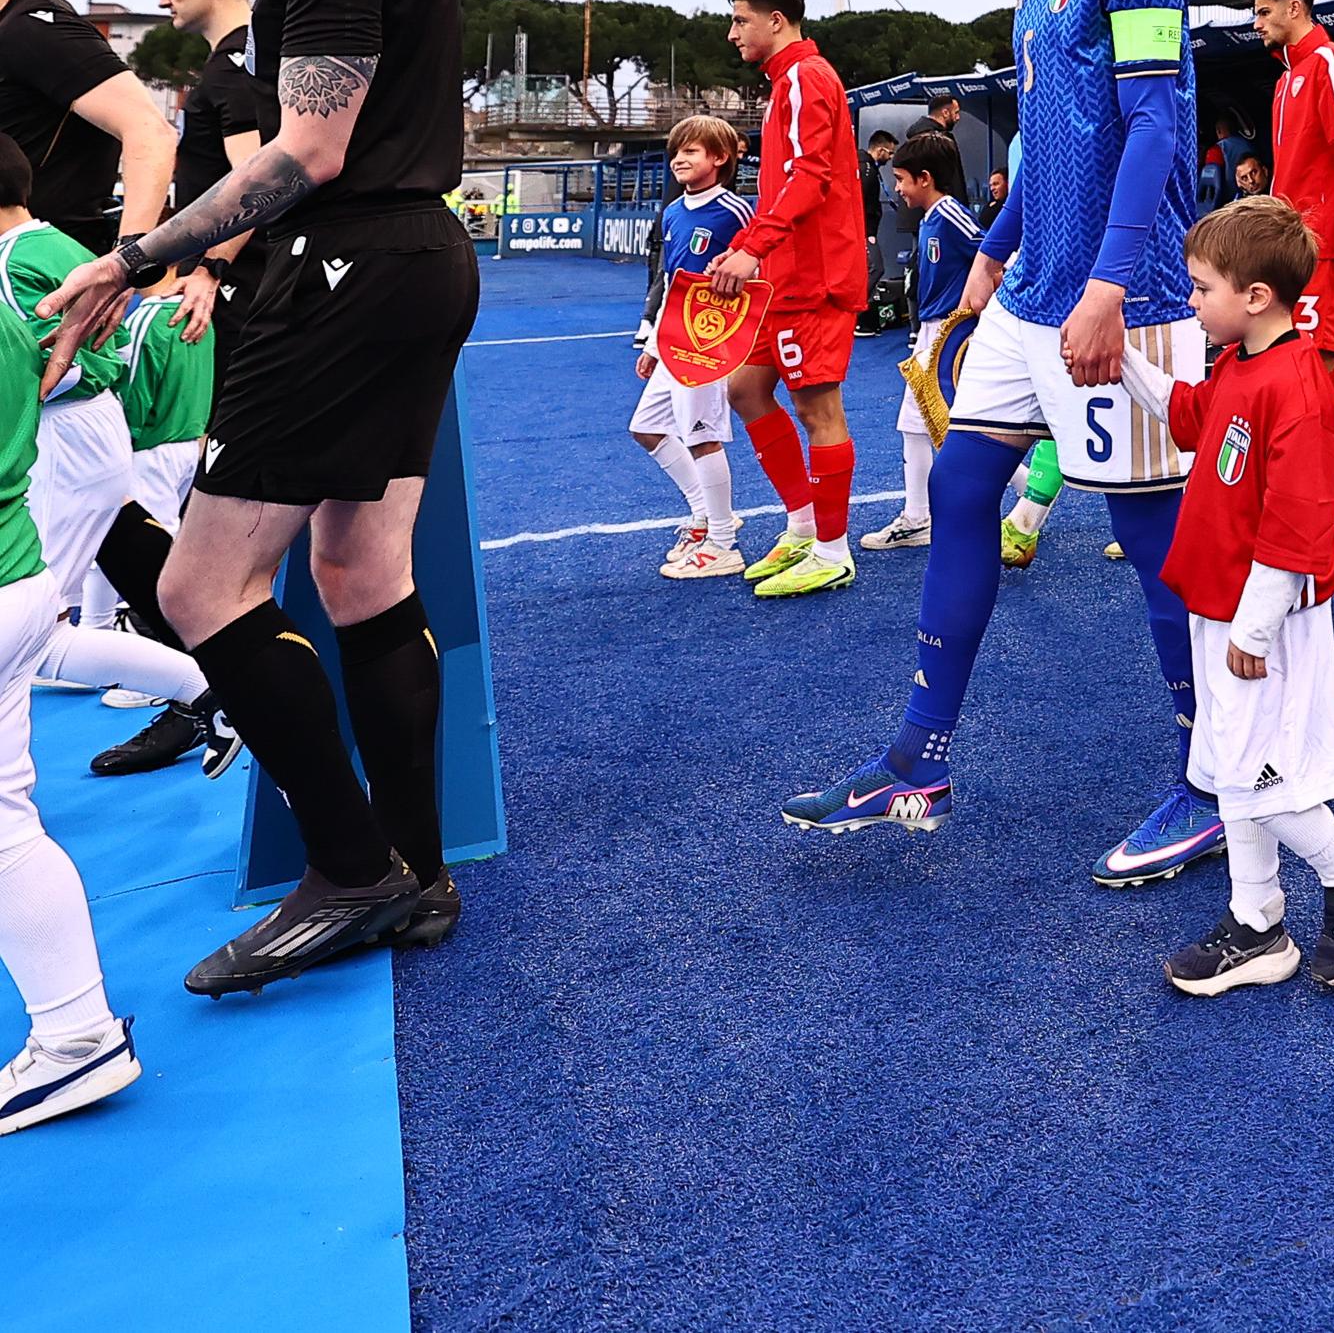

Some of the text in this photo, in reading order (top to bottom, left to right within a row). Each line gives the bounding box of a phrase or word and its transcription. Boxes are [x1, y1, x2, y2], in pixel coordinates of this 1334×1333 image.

[509, 236, 583, 252] empolifc.com
[603, 218, 633, 254] EMPOLI
[1295, 295, 1320, 331] 3
[777, 329, 803, 368] 6
[1086, 397, 1114, 463] 5
[1227, 427, 1249, 450] ITALIA
[1253, 775, 1284, 791] adidas
[303, 906, 372, 922] F50
